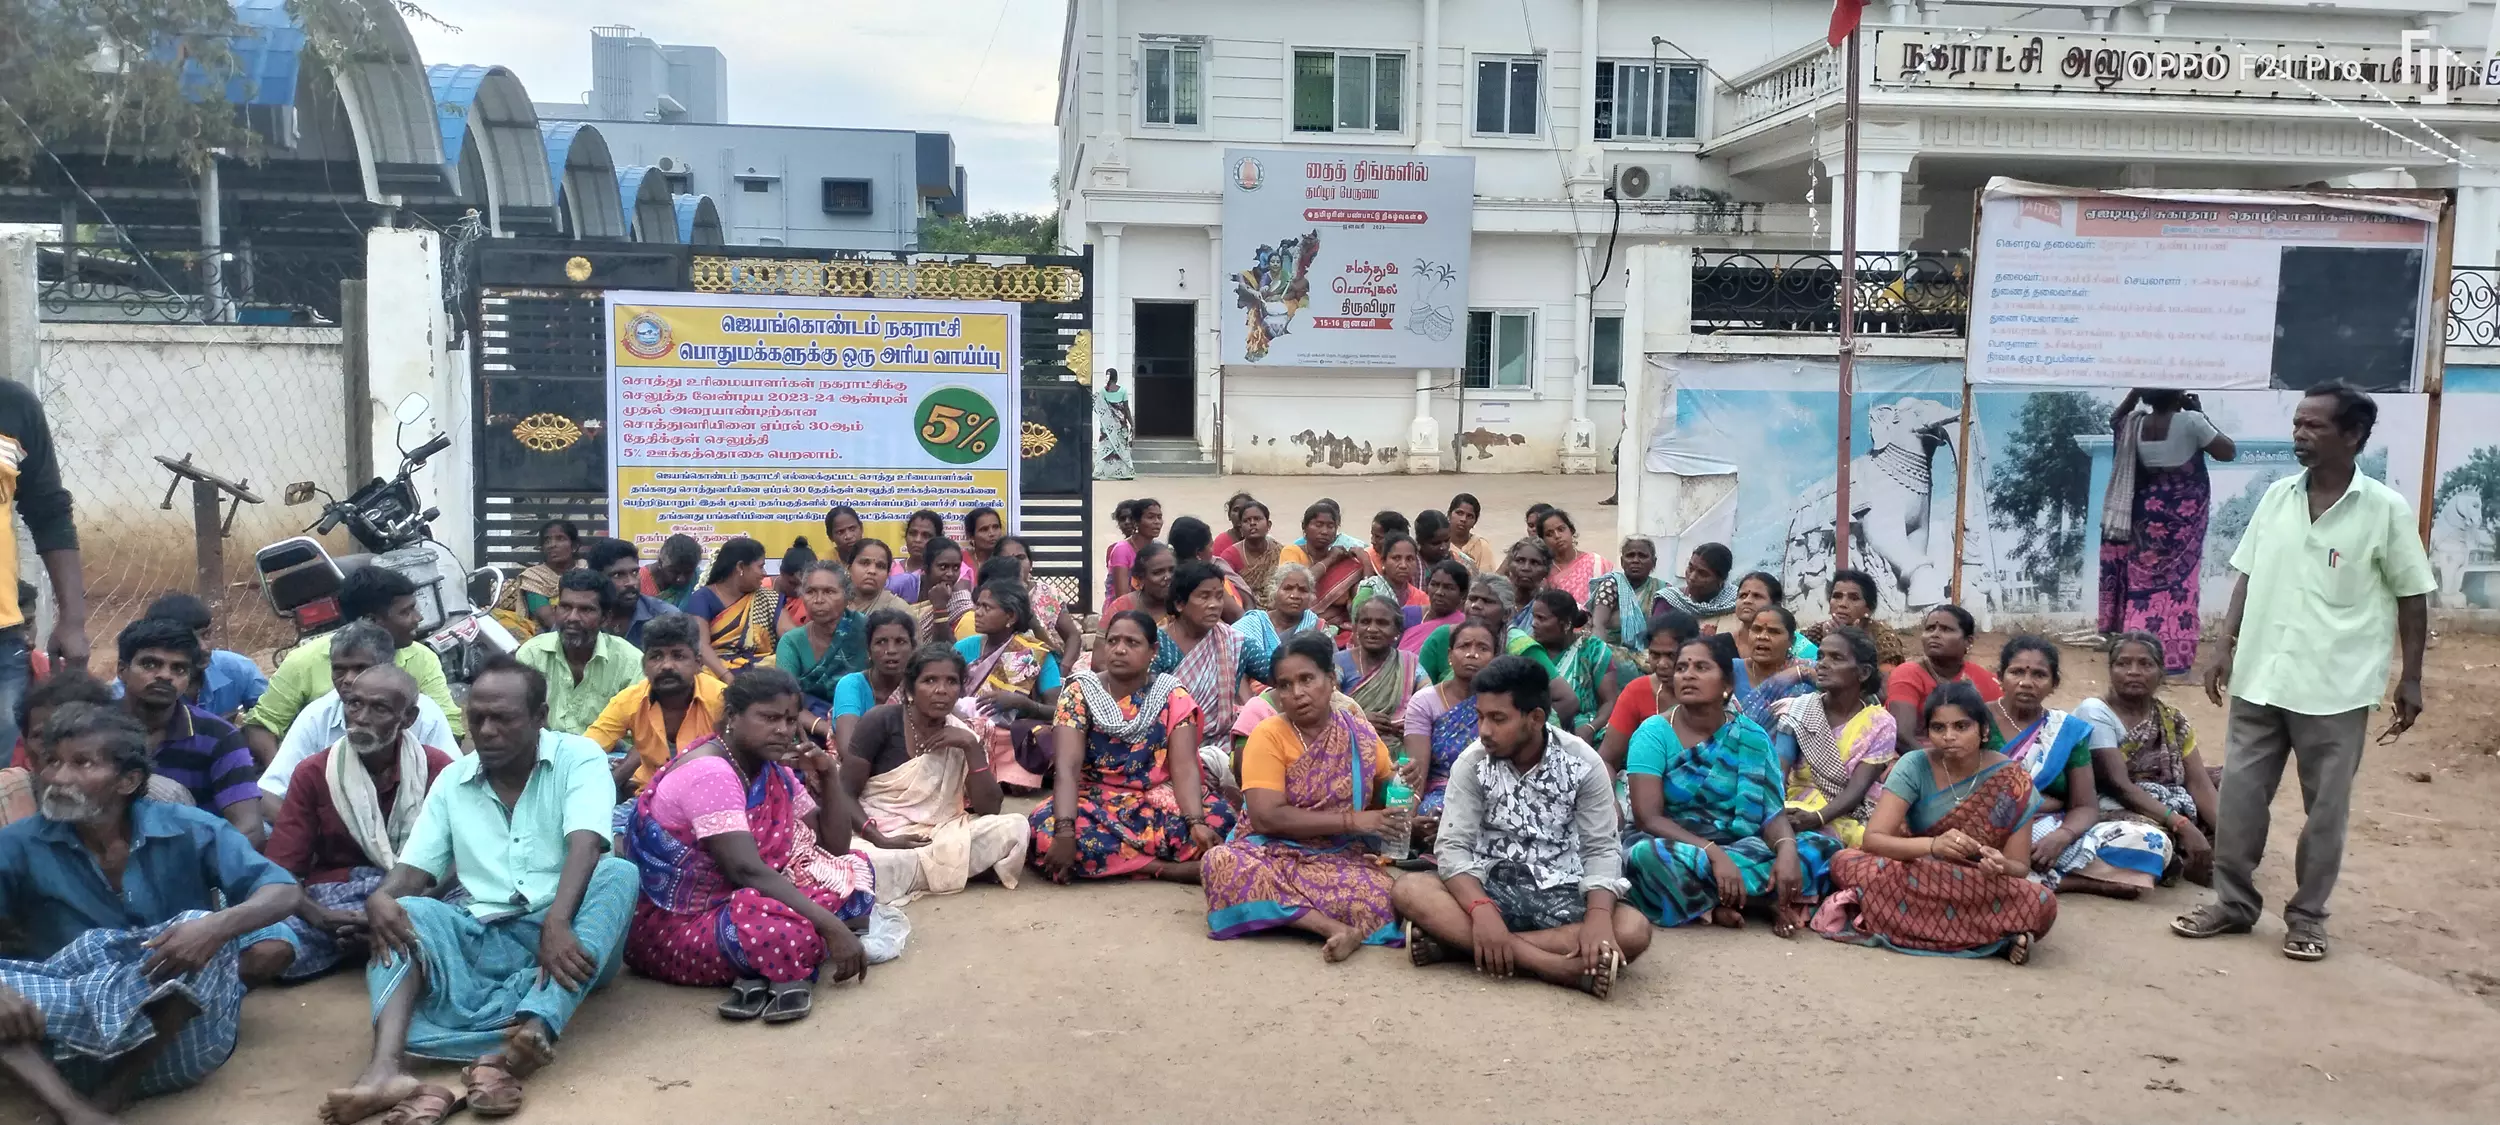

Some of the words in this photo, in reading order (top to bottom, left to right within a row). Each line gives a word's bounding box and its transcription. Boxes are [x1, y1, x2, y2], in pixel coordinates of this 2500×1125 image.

[1900, 37, 2043, 79] நகராட்சி
[1306, 159, 1347, 182] தைத்
[1353, 160, 1429, 183] திங்களில்
[1305, 184, 1336, 201] தமிழர்
[2154, 209, 2219, 222] சுகாதார
[2228, 209, 2355, 224] தொழிலாளர்கள்
[1345, 259, 1399, 285] சமத்துவ
[1332, 276, 1398, 297] பொங்கல்
[1341, 298, 1396, 318] திருவிழா
[721, 311, 880, 336] ஜெயங்கொண்டம்
[884, 316, 961, 339] நகராட்சி
[1320, 319, 1340, 327] 15-16
[1342, 318, 1376, 329] ஜனவரி
[679, 340, 838, 366] பொதுமக்களுக்கு
[842, 347, 876, 368] ஒரு
[880, 344, 929, 365] அரிய
[933, 344, 1001, 370] வாய்ப்பு
[622, 375, 682, 388] சொத்து
[686, 376, 815, 388] உரிமையாளர்கள்
[818, 379, 908, 391] நகராட்சிக்கு
[622, 390, 688, 403] செலுத்த
[692, 391, 764, 403] வேண்டிய
[768, 392, 835, 402] 2023-24
[840, 392, 908, 405] ஆண்டின்
[622, 404, 665, 416] முதல்
[669, 405, 817, 418] அரையாண்டிற்கான
[623, 418, 756, 432] சொத்துவரியினை
[760, 420, 805, 432] ஏப்ரல்
[809, 420, 864, 433] 30ஆம்
[921, 402, 998, 455] 5%
[623, 433, 700, 445] தேதிக்குள்
[704, 434, 769, 447] செலுத்தி
[624, 448, 642, 458] 5%
[646, 448, 764, 460] ஊக்கத்தொகை
[768, 449, 843, 461] பெறலாம்.
[656, 471, 739, 481] ஜெயங்கொண்டம்
[740, 472, 780, 481] நகராட்சி
[859, 472, 895, 482] சொத்து
[897, 472, 973, 482] உரிமையாளர்கள்
[630, 484, 677, 494] தங்களது
[679, 484, 760, 495] சொத்துவரியினை
[763, 485, 791, 494] ஏப்ரல்
[808, 485, 854, 494] தேதிக்குள்
[856, 485, 895, 496] செலுத்தி
[623, 498, 697, 509] பெற்றிடுமாறும்
[699, 498, 727, 508] இதன்
[728, 499, 757, 508] மூலம்
[920, 499, 957, 508] வளர்ச்சி
[658, 511, 704, 521] தங்களது
[706, 511, 774, 521] பங்களிப்பினை
